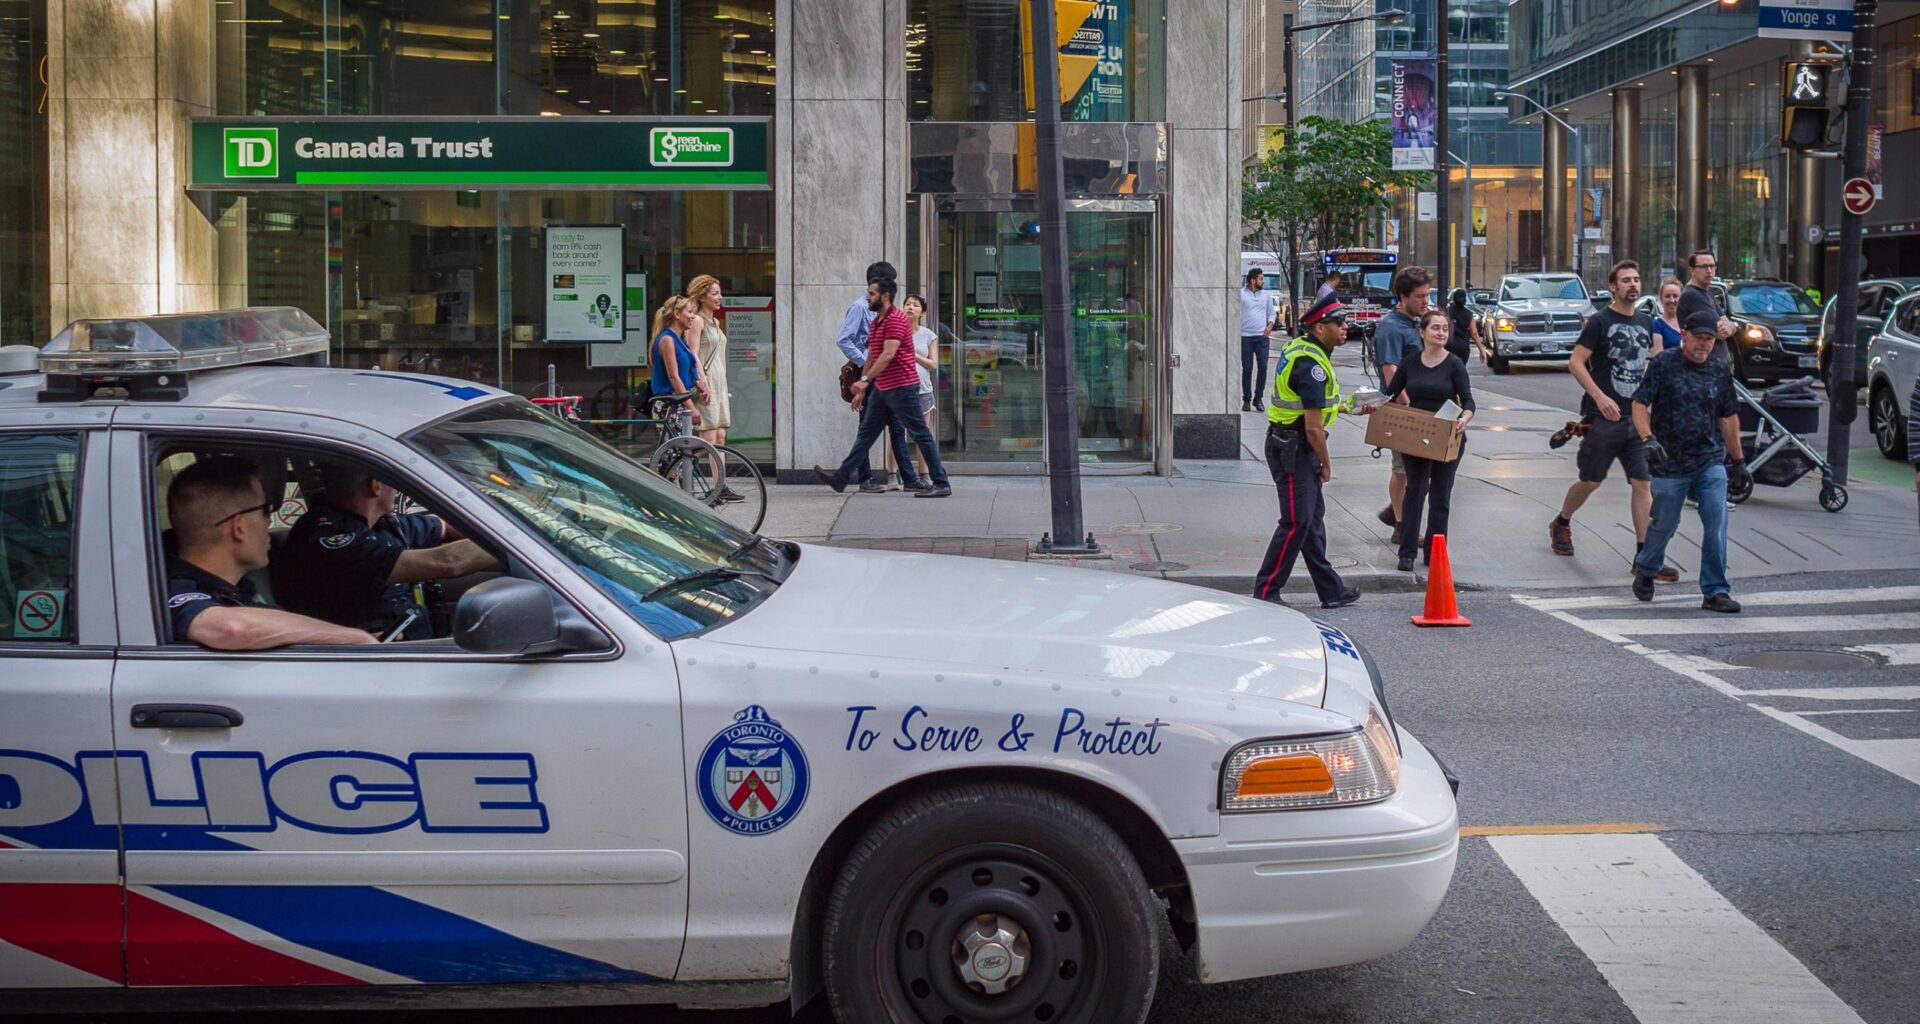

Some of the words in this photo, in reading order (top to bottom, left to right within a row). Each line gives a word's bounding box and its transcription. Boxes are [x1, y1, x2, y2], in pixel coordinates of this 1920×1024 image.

[1780, 9, 1819, 27] Yonge
[1825, 14, 1836, 25] St
[1394, 64, 1405, 118] CONNECT
[229, 138, 273, 168] TD
[295, 136, 404, 159] Canada
[411, 137, 493, 158] Trust
[678, 142, 722, 152] machine
[1873, 128, 1882, 159] BEAUTY
[553, 233, 576, 242] Ready
[577, 233, 585, 241] to
[552, 251, 571, 259] back
[572, 251, 599, 259] around
[985, 247, 997, 256] 110
[552, 260, 572, 268] every
[722, 724, 785, 743] TORONTO
[845, 705, 880, 752] To
[892, 705, 984, 753] Serve
[997, 713, 1035, 752] &
[1053, 707, 1170, 757] Protect
[0, 750, 549, 834] OLICE
[730, 819, 776, 832] POLICE
